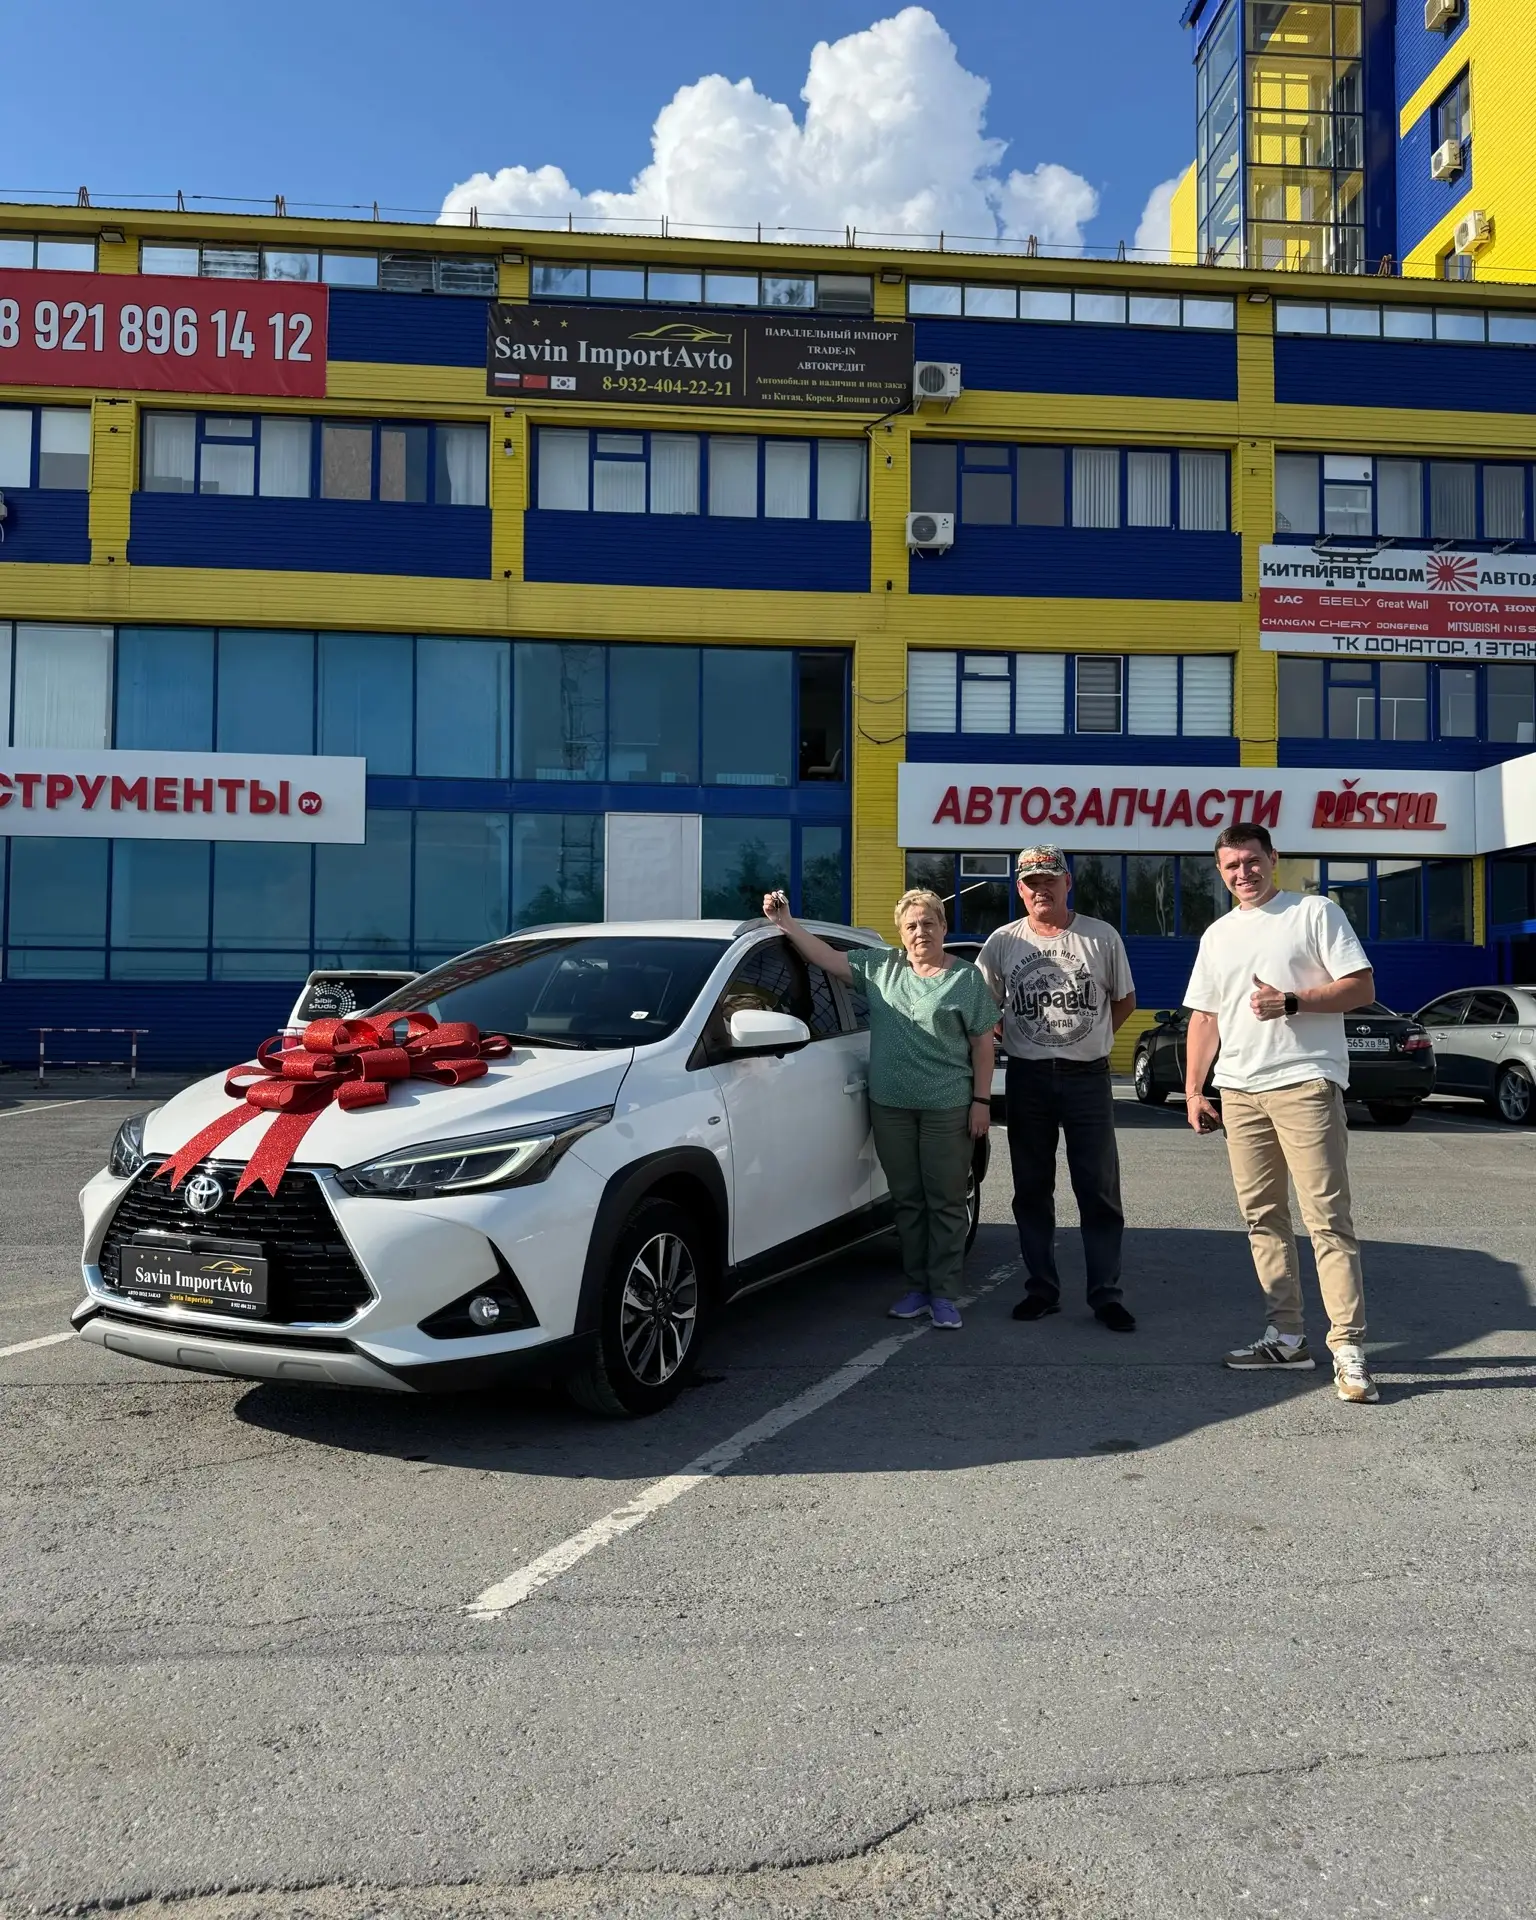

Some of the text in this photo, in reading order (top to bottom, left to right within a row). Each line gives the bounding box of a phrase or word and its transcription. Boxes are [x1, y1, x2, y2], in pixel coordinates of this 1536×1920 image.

[0, 298, 313, 362] 8 921 896 14 12
[765, 327, 899, 341] ПАРАЛЛЕЛЬНЫЙ ИМПОРТ
[494, 335, 733, 371] Savin ImportAvto
[807, 345, 856, 356] TRADE-IN
[797, 361, 866, 372] АВТОКРЕДИТ
[602, 375, 733, 396] 8-932-404-22-21
[755, 376, 809, 386] Автомобили
[819, 380, 857, 388] наличии
[884, 382, 907, 390] заказ
[773, 392, 804, 402] Китая,
[805, 393, 835, 404] Кореи,
[836, 394, 871, 404] Японии
[880, 396, 901, 405] ОАЭ
[1262, 561, 1425, 583] КИТАЙАВТОДОМ
[1273, 594, 1304, 604] JAC
[1319, 596, 1372, 607] GEELY
[1376, 598, 1404, 609] Great
[1406, 599, 1429, 610] Wall
[1447, 601, 1500, 613] TOYOTA
[1261, 617, 1536, 633] CHANGAN CHERY DONGFENG MITSUBISHI NISS
[1332, 636, 1360, 651] ТК
[931, 785, 1284, 829] АВТОЗАПЧАСТИ
[135, 1266, 253, 1295] Savin ImportAvto
[169, 1293, 214, 1305] Savin ImportAvto
